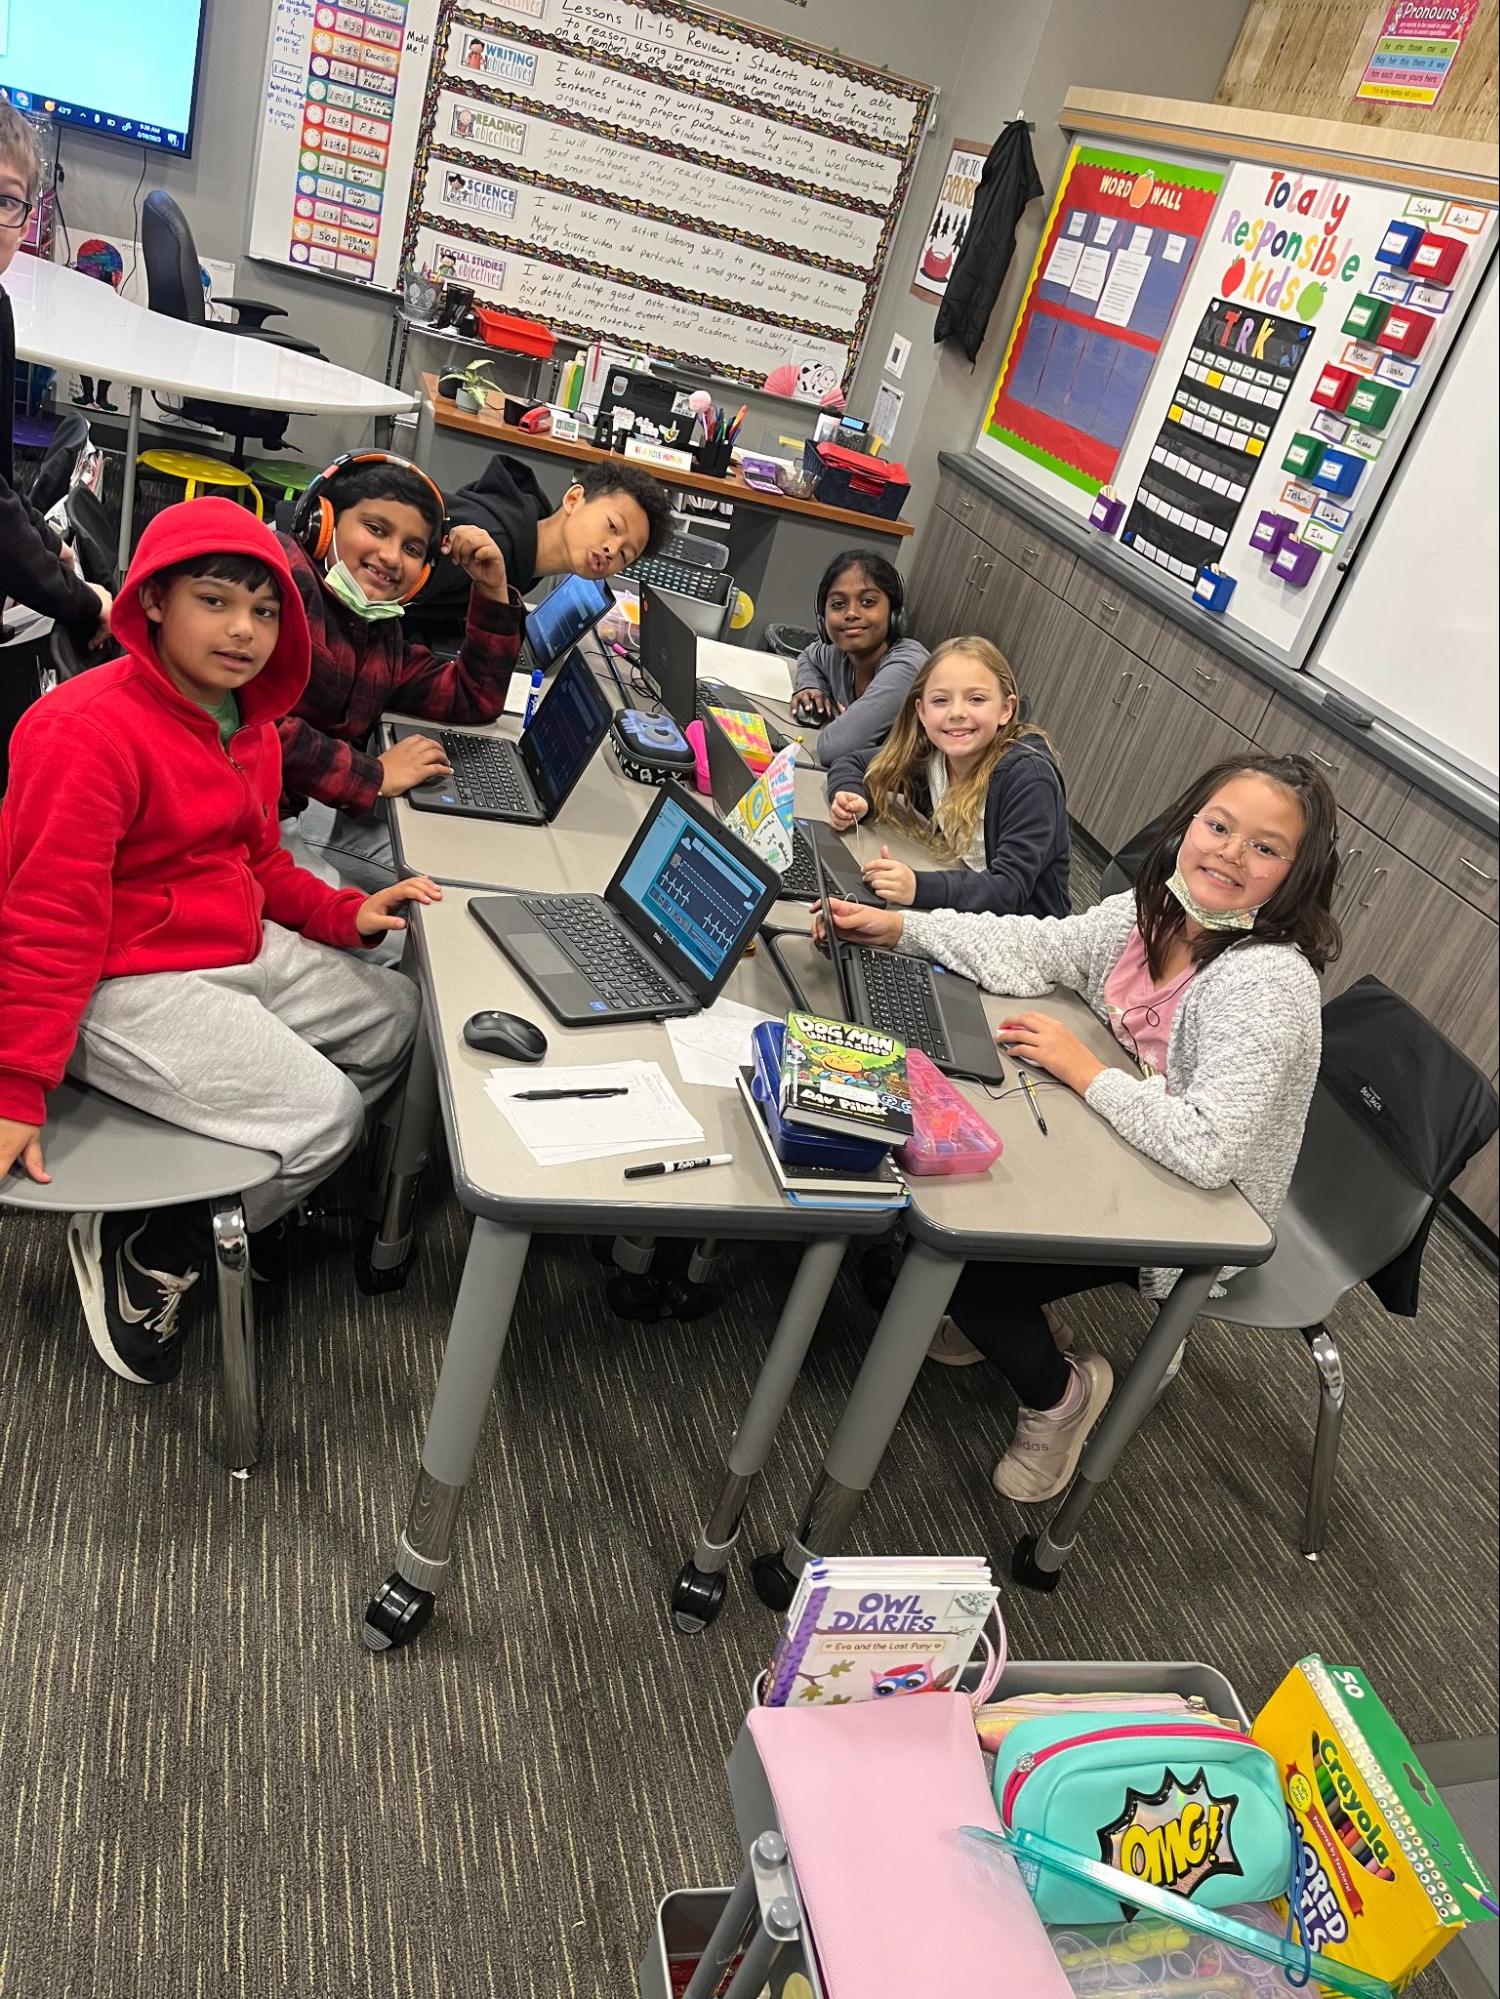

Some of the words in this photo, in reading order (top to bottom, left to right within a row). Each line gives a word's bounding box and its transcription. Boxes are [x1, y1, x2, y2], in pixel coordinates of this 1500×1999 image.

[1402, 3, 1459, 20] Pronouns
[368, 26, 394, 40] MATH
[406, 43, 424, 56] Me!
[486, 43, 534, 67] WRITING
[562, 0, 622, 25] Lessons
[634, 13, 674, 38] 11-15
[749, 55, 798, 81] Students
[810, 77, 834, 89] will
[844, 86, 857, 100] be
[870, 96, 894, 111] able
[573, 34, 580, 42] a
[587, 36, 624, 54] number
[666, 62, 683, 72] well
[689, 68, 701, 78] as
[487, 56, 532, 83] objectives
[564, 17, 580, 30] to
[586, 23, 627, 45] reason
[636, 42, 667, 58] using
[675, 52, 736, 77] benchmarks
[744, 72, 767, 86] when
[825, 96, 844, 109] two
[852, 102, 896, 126] fractions
[556, 60, 569, 72] I
[574, 69, 596, 80] will
[602, 76, 647, 98] practice
[655, 93, 672, 106] my
[677, 100, 714, 121] writing
[764, 124, 776, 142] by
[826, 145, 837, 156] in
[556, 94, 611, 116] organized
[616, 110, 662, 130] paragraph
[475, 113, 524, 136] READING
[475, 124, 522, 150] objectives
[616, 96, 642, 110] with
[650, 106, 688, 124] proper
[692, 119, 750, 143] punctuation
[825, 160, 848, 173] well
[352, 145, 380, 160] LUNCH
[955, 156, 970, 175] TIME
[970, 160, 980, 177] TO
[549, 128, 562, 142] I
[566, 138, 588, 148] will
[596, 145, 640, 164] improve
[650, 160, 665, 174] my
[674, 166, 716, 188] reading
[801, 202, 812, 216] by
[820, 210, 854, 229] making
[564, 164, 592, 178] small
[468, 180, 516, 202] SCIENCE
[468, 191, 514, 216] objectives
[640, 170, 680, 192] studying
[689, 185, 704, 198] my
[760, 207, 783, 220] notes
[1100, 174, 1131, 199] WORD
[1150, 188, 1181, 211] WALL
[1265, 171, 1350, 236] Totally
[440, 246, 470, 266] SOCIAL
[472, 254, 504, 274] STUDIES
[529, 232, 548, 244] and
[552, 240, 598, 260] activities
[530, 214, 558, 235] Mystery
[562, 224, 590, 244] Science
[592, 237, 614, 250] video
[620, 243, 634, 253] and
[640, 250, 685, 268] participate
[726, 271, 746, 284] group
[750, 278, 764, 288] and
[768, 282, 788, 294] whole
[534, 196, 546, 207] I
[552, 204, 572, 214] will
[581, 211, 598, 222] use
[605, 216, 622, 231] my
[632, 226, 658, 240] active
[664, 231, 695, 254] listening
[734, 255, 744, 265] to
[751, 262, 766, 276] pay
[770, 270, 812, 286] attention
[818, 280, 829, 289] to
[833, 284, 848, 296] the
[1222, 210, 1360, 282] Responsible
[458, 264, 500, 287] objectives
[523, 262, 538, 276] I
[542, 272, 564, 283] will
[572, 277, 604, 296] develop
[610, 289, 636, 302] good
[645, 298, 700, 322] note-taking
[746, 324, 764, 336] and
[770, 331, 798, 346] write
[802, 338, 826, 353] down
[584, 298, 631, 316] important
[672, 319, 692, 330] and
[697, 325, 739, 344] academic
[746, 338, 790, 357] vocabulary
[600, 316, 646, 332] notebook
[1220, 310, 1276, 360] TRK
[654, 932, 663, 944] DELL
[794, 1017, 842, 1038] DOG
[847, 1029, 894, 1052] MAN
[806, 1032, 890, 1056] UNLEASHED
[800, 1088, 836, 1104] DAV
[858, 1592, 923, 1614] OWL
[828, 1611, 936, 1632] DIARIES
[854, 1642, 872, 1650] and
[874, 1642, 888, 1650] the
[889, 1642, 908, 1650] Lost
[911, 1642, 932, 1652] Pony
[1334, 1670, 1364, 1698] 50
[1320, 1738, 1391, 1864] Crayola
[1120, 1802, 1223, 1887] OMG!
[1312, 1815, 1332, 1848] Preferred
[1330, 1848, 1337, 1858] by
[1336, 1856, 1352, 1893] Teachers!
[1303, 1846, 1346, 1939] ORED
